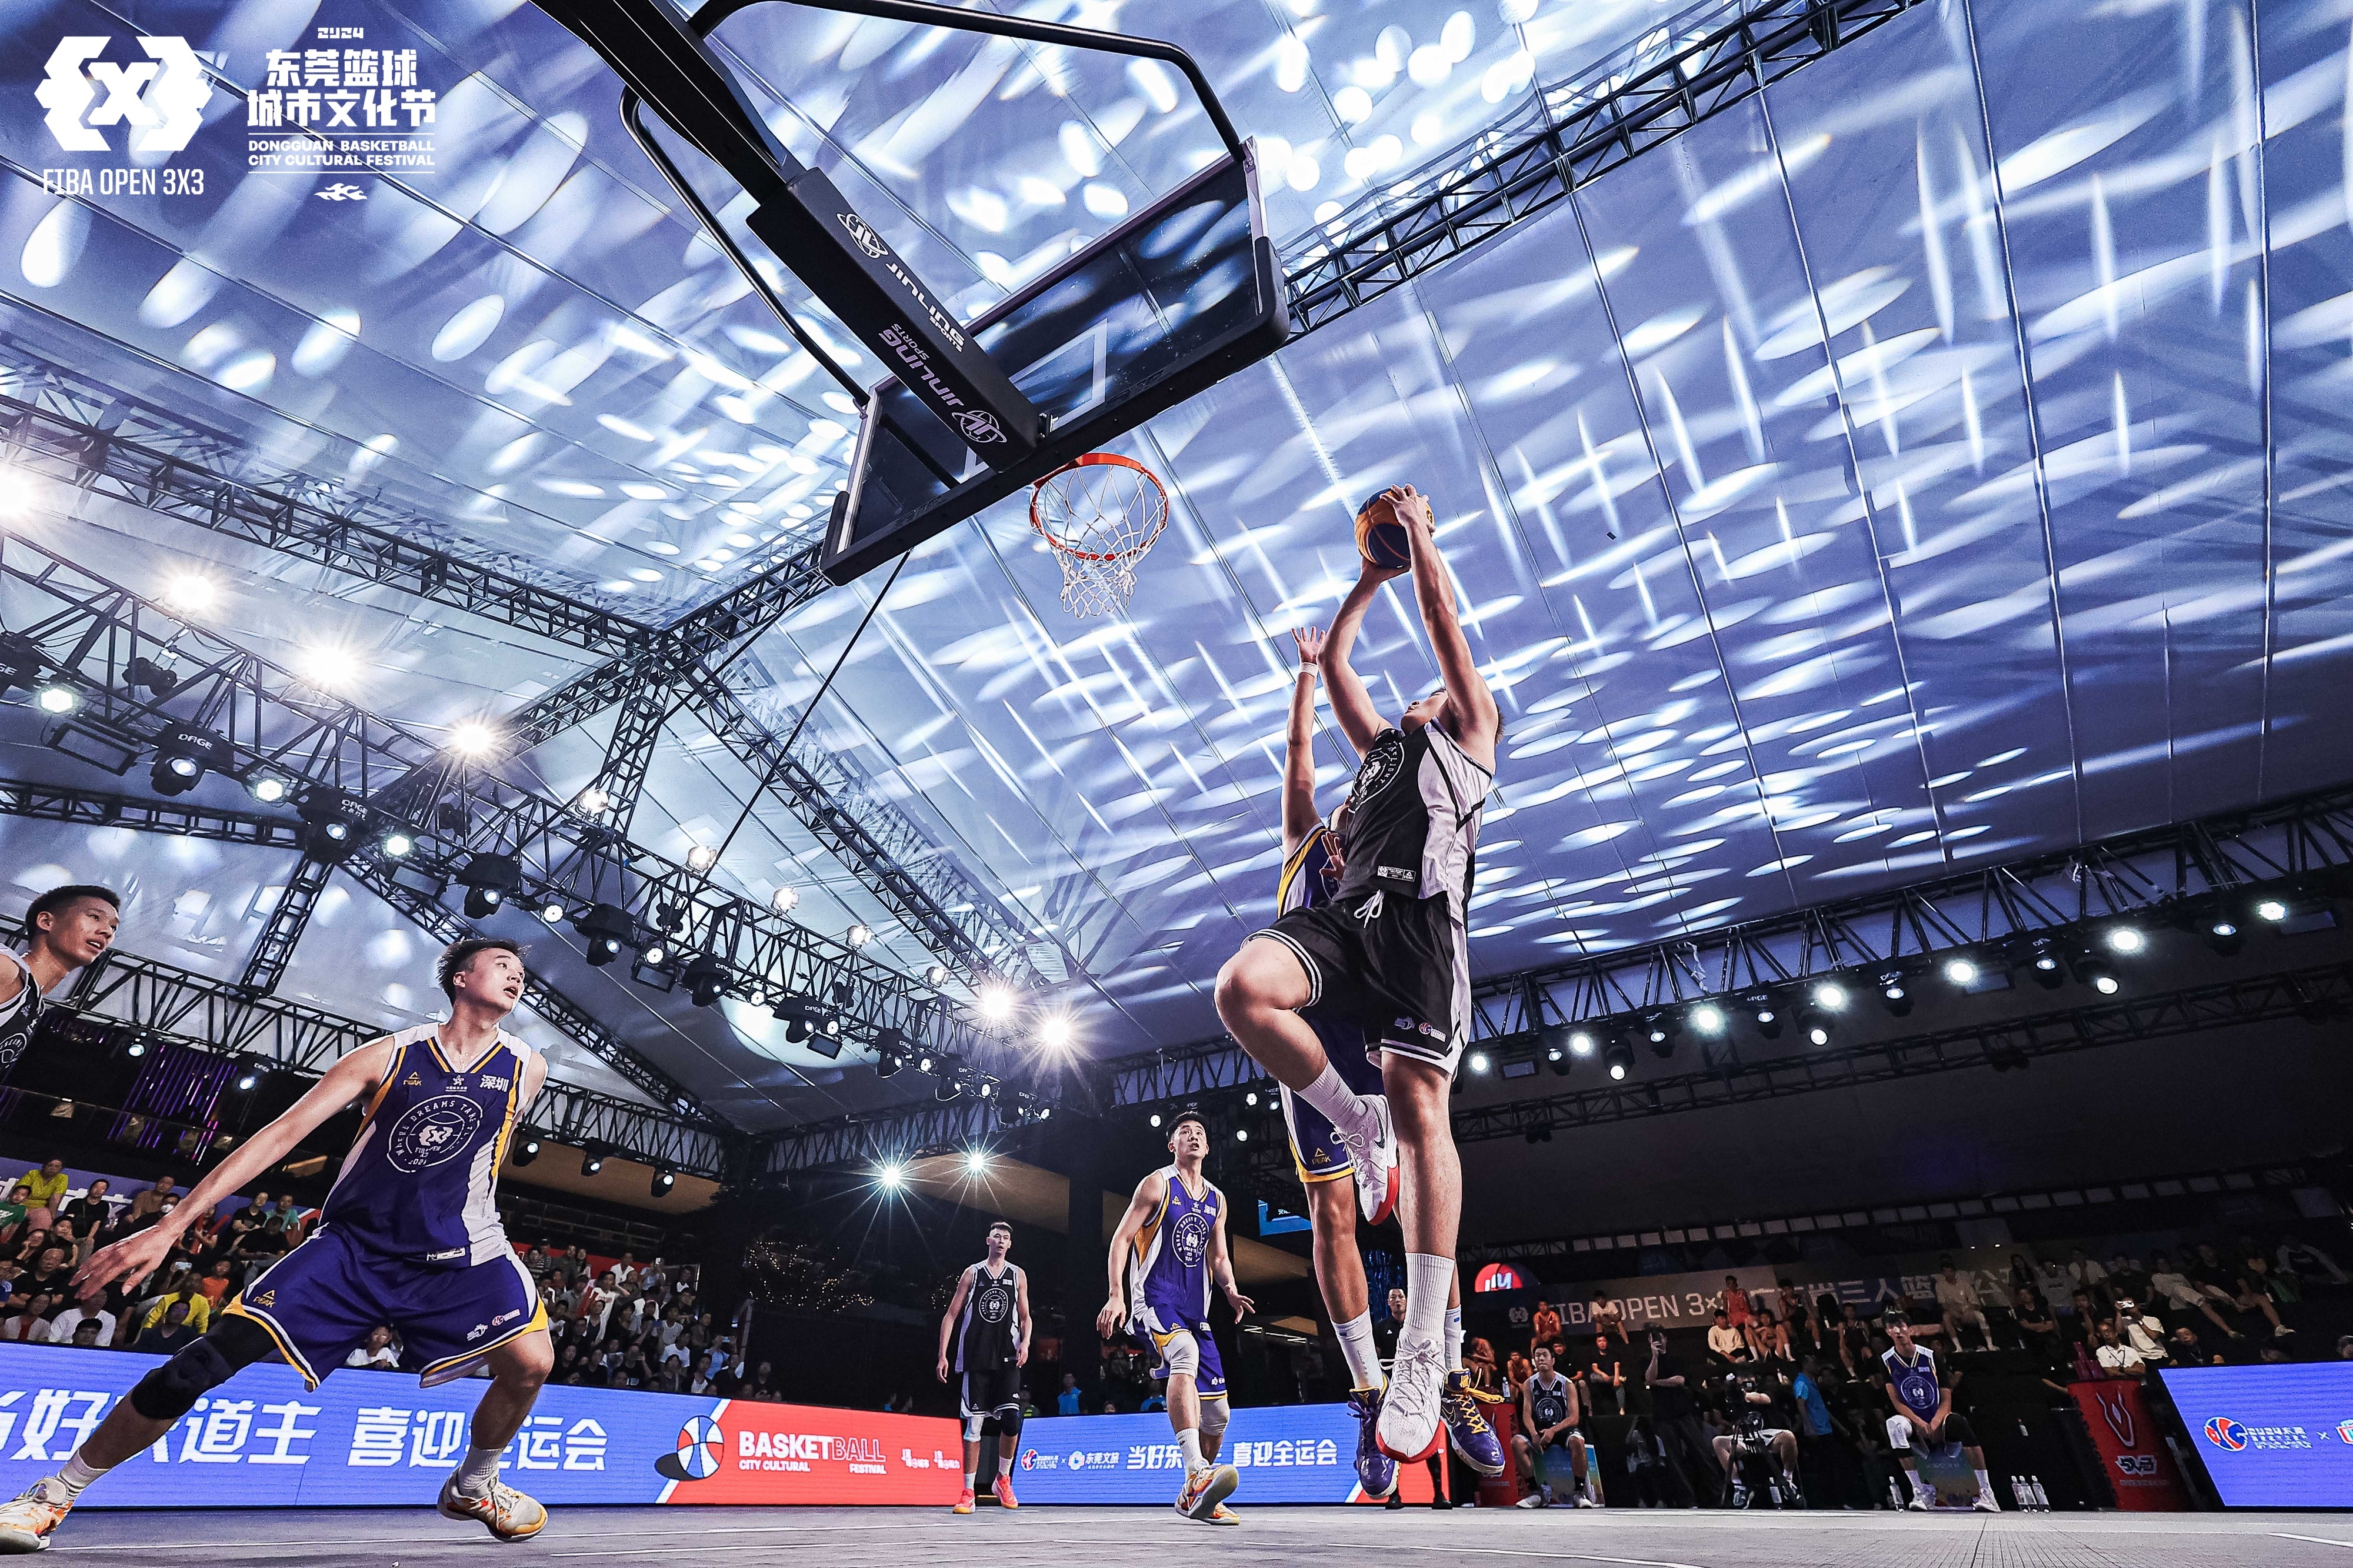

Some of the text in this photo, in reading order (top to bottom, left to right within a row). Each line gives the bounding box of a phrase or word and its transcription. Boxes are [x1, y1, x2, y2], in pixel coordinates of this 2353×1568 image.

[891, 323, 929, 360] SPORTS
[928, 315, 963, 353] SPORTS
[178, 733, 214, 750] DAGE
[342, 799, 368, 815] DAGE
[716, 963, 732, 974] DAGE
[805, 1005, 821, 1013] DAGE
[479, 1074, 509, 1092] 深圳
[410, 1100, 455, 1122] DREAMS
[1312, 1156, 1331, 1165] PEAK
[253, 1296, 275, 1308] PEAK
[0, 1389, 322, 1464] 好道主
[738, 1430, 886, 1462] BASKETBALL
[1234, 1439, 1338, 1467] 喜迎全运会
[739, 1459, 886, 1474] CITY CULTURAL FESTIVAL
